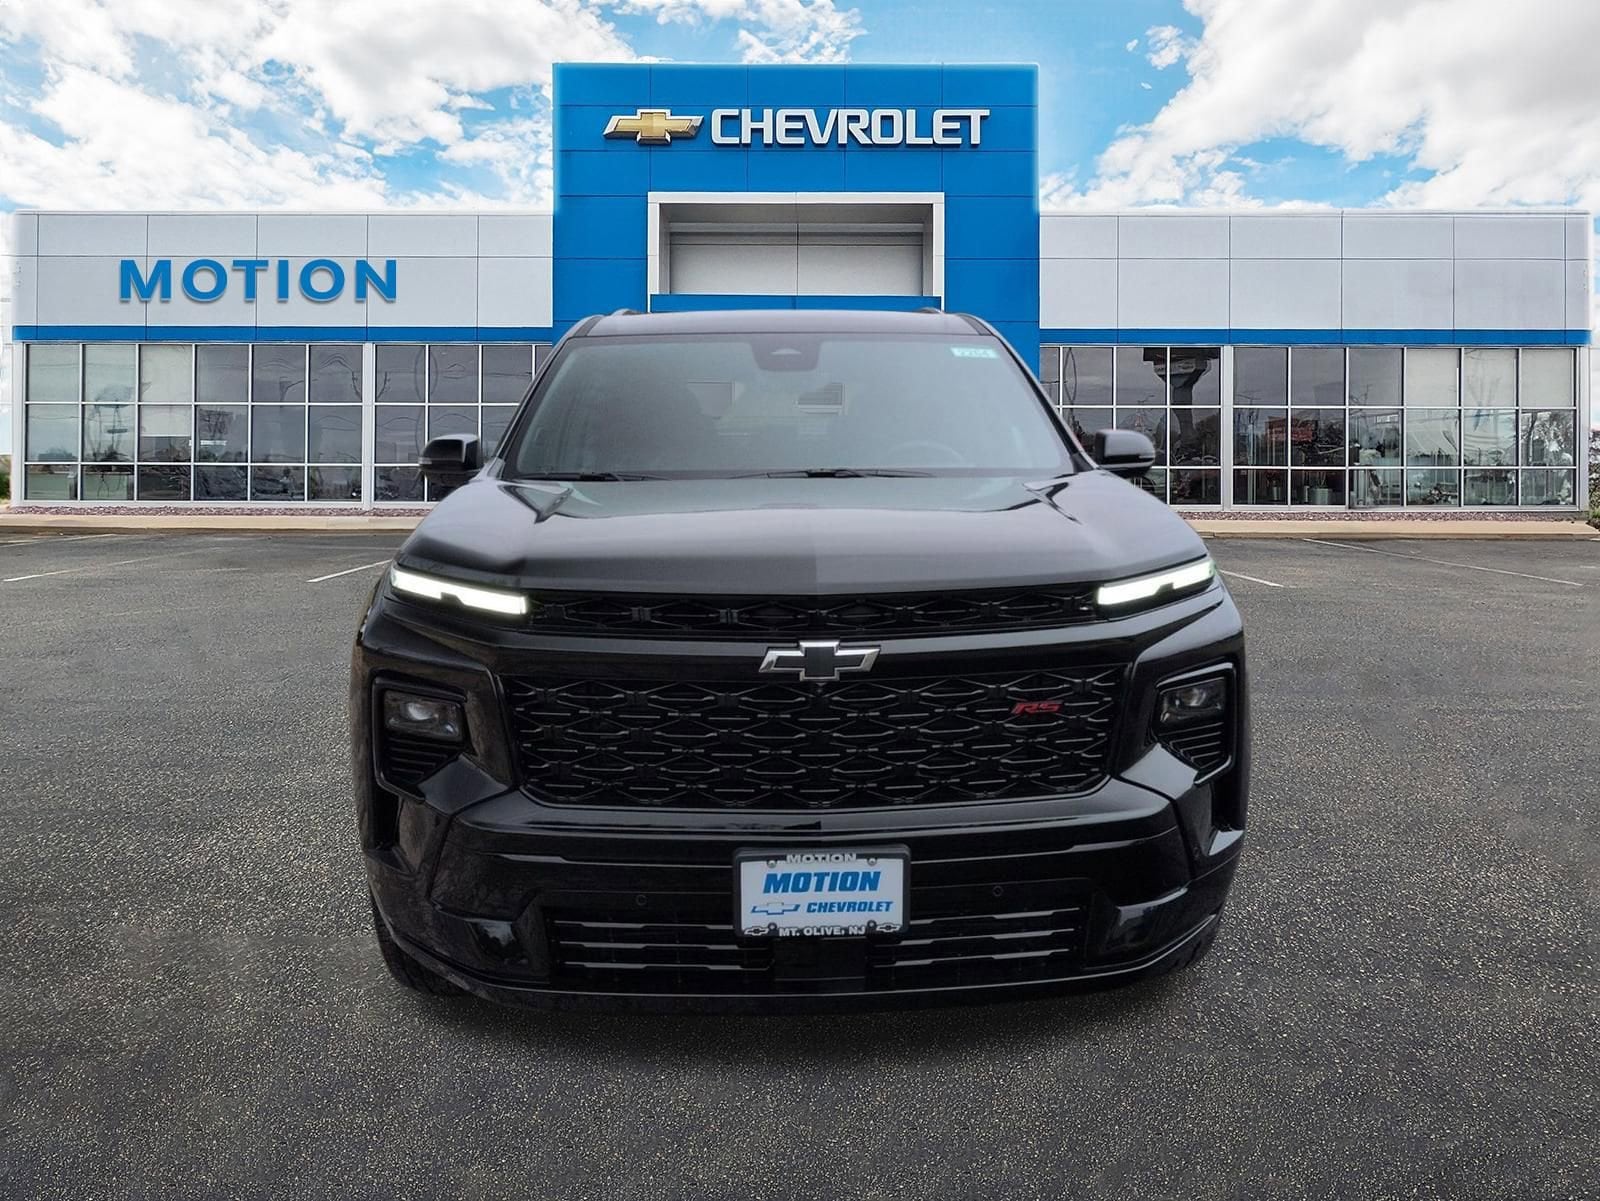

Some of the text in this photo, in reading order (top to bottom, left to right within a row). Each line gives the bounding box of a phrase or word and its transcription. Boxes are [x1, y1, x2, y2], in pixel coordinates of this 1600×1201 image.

[711, 108, 990, 146] CHEVROLET
[119, 258, 397, 302] MOTION
[1011, 702, 1061, 715] RS
[786, 853, 857, 865] MOTION
[762, 871, 881, 894] MOTION
[806, 901, 893, 914] CHEVROLET
[779, 925, 866, 937] MT. OLIVE, NJ
